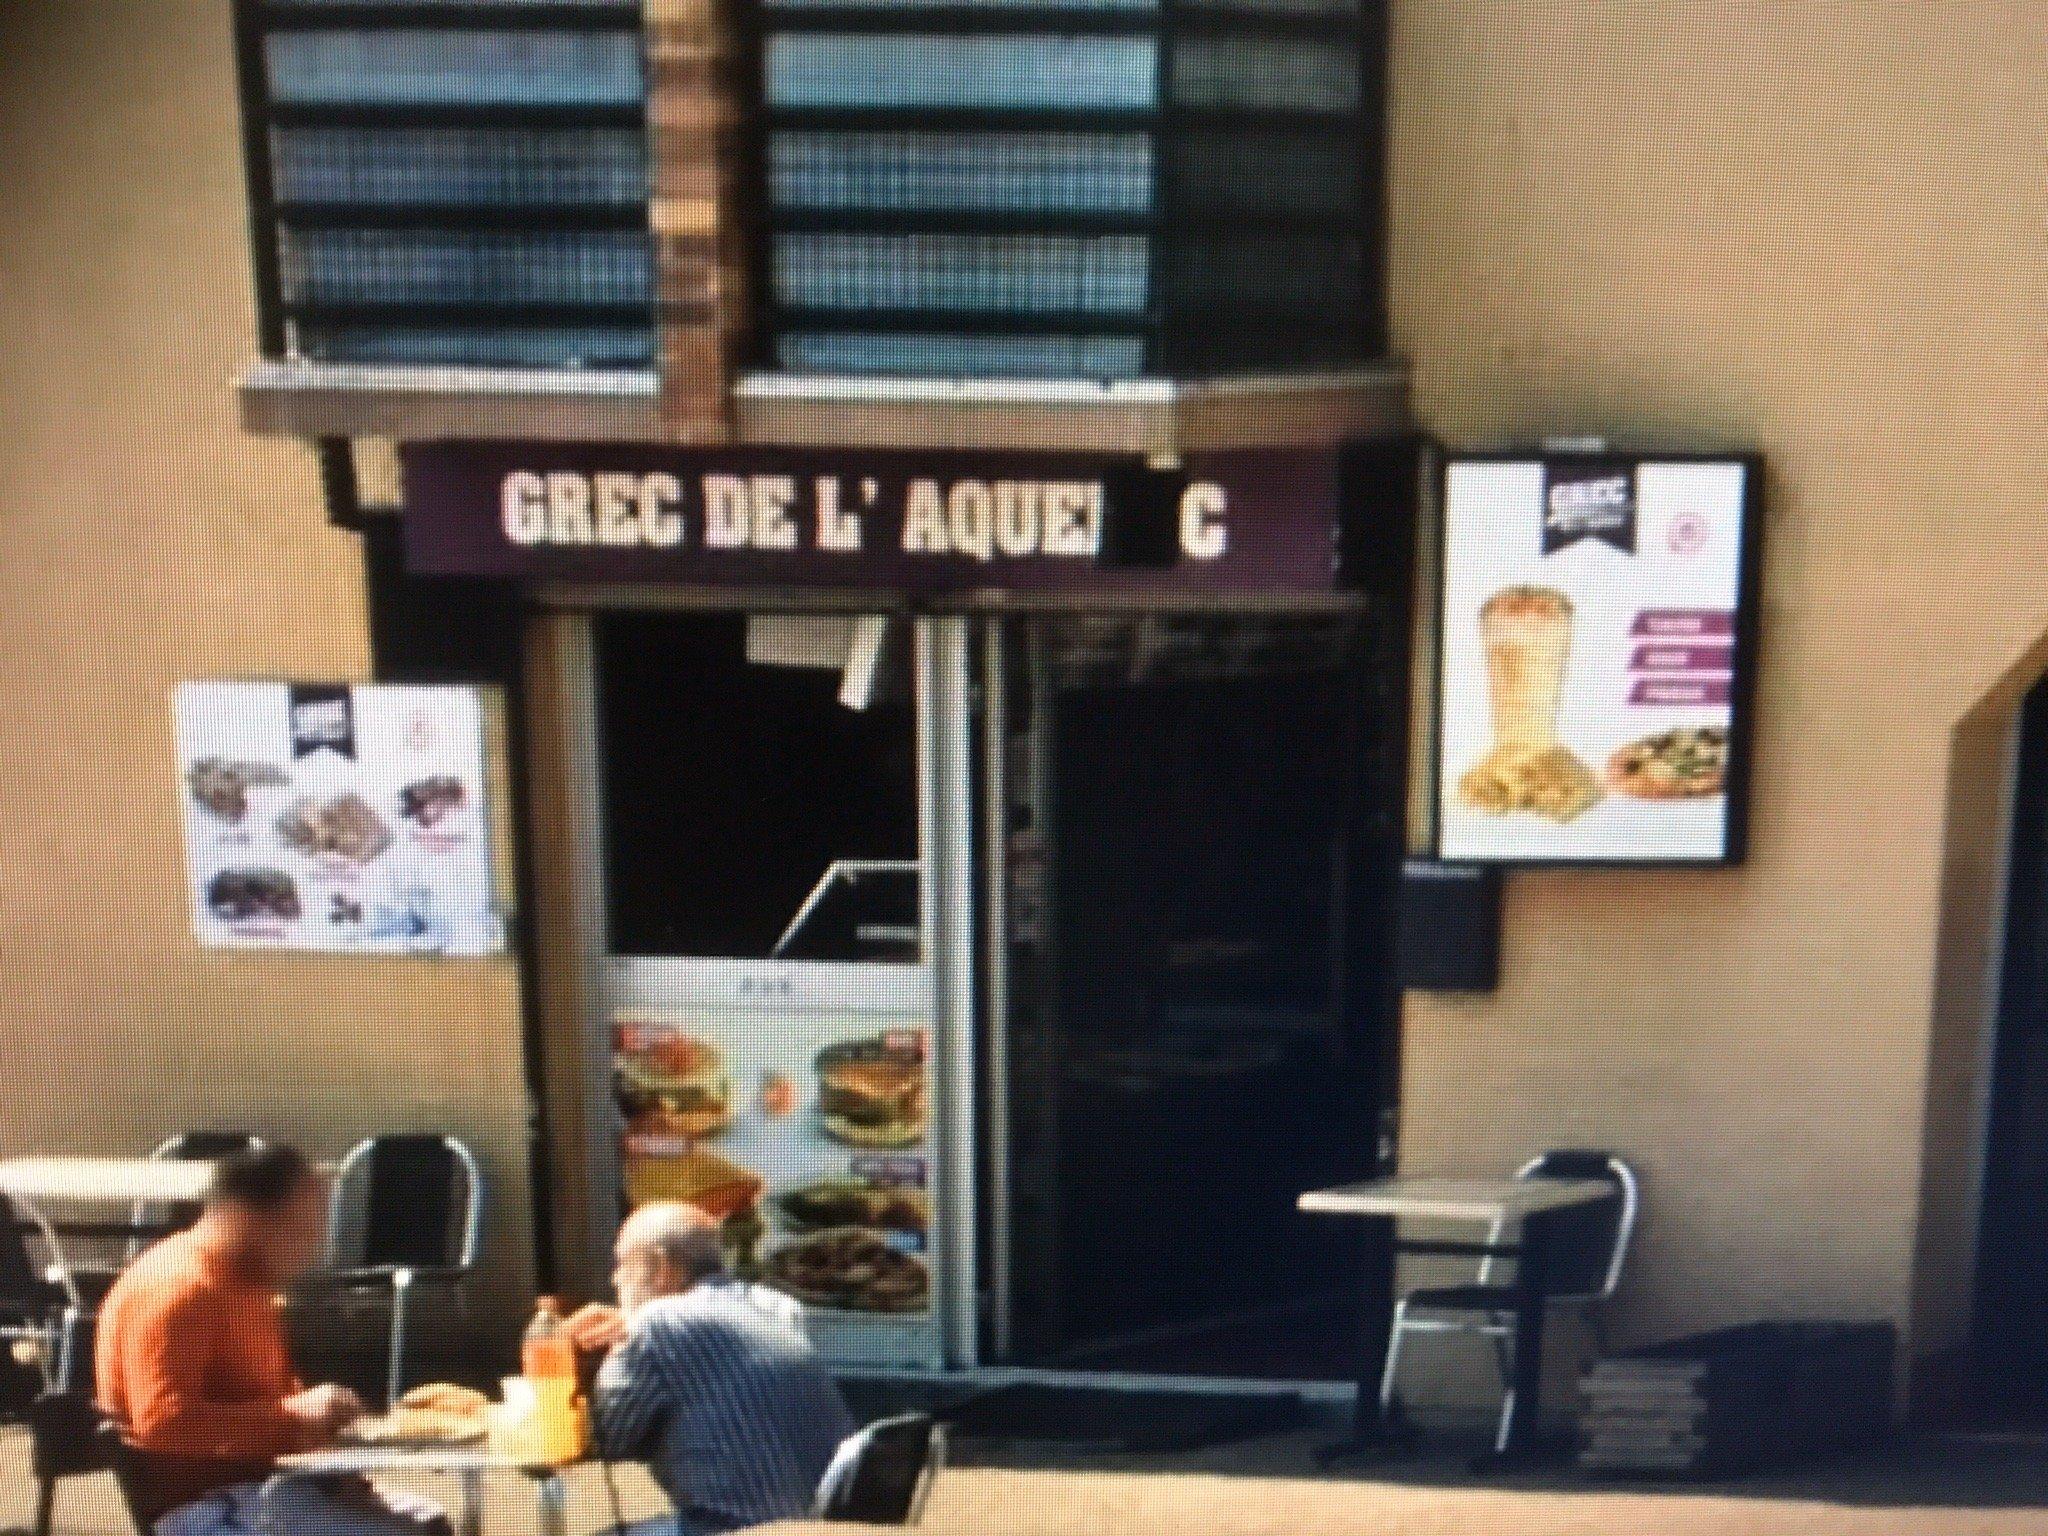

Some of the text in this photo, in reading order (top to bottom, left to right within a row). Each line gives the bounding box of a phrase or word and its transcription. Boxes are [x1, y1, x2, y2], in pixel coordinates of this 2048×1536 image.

[503, 470, 685, 547] GREC
[703, 474, 799, 550] DE
[902, 478, 1228, 562] AQUEC
